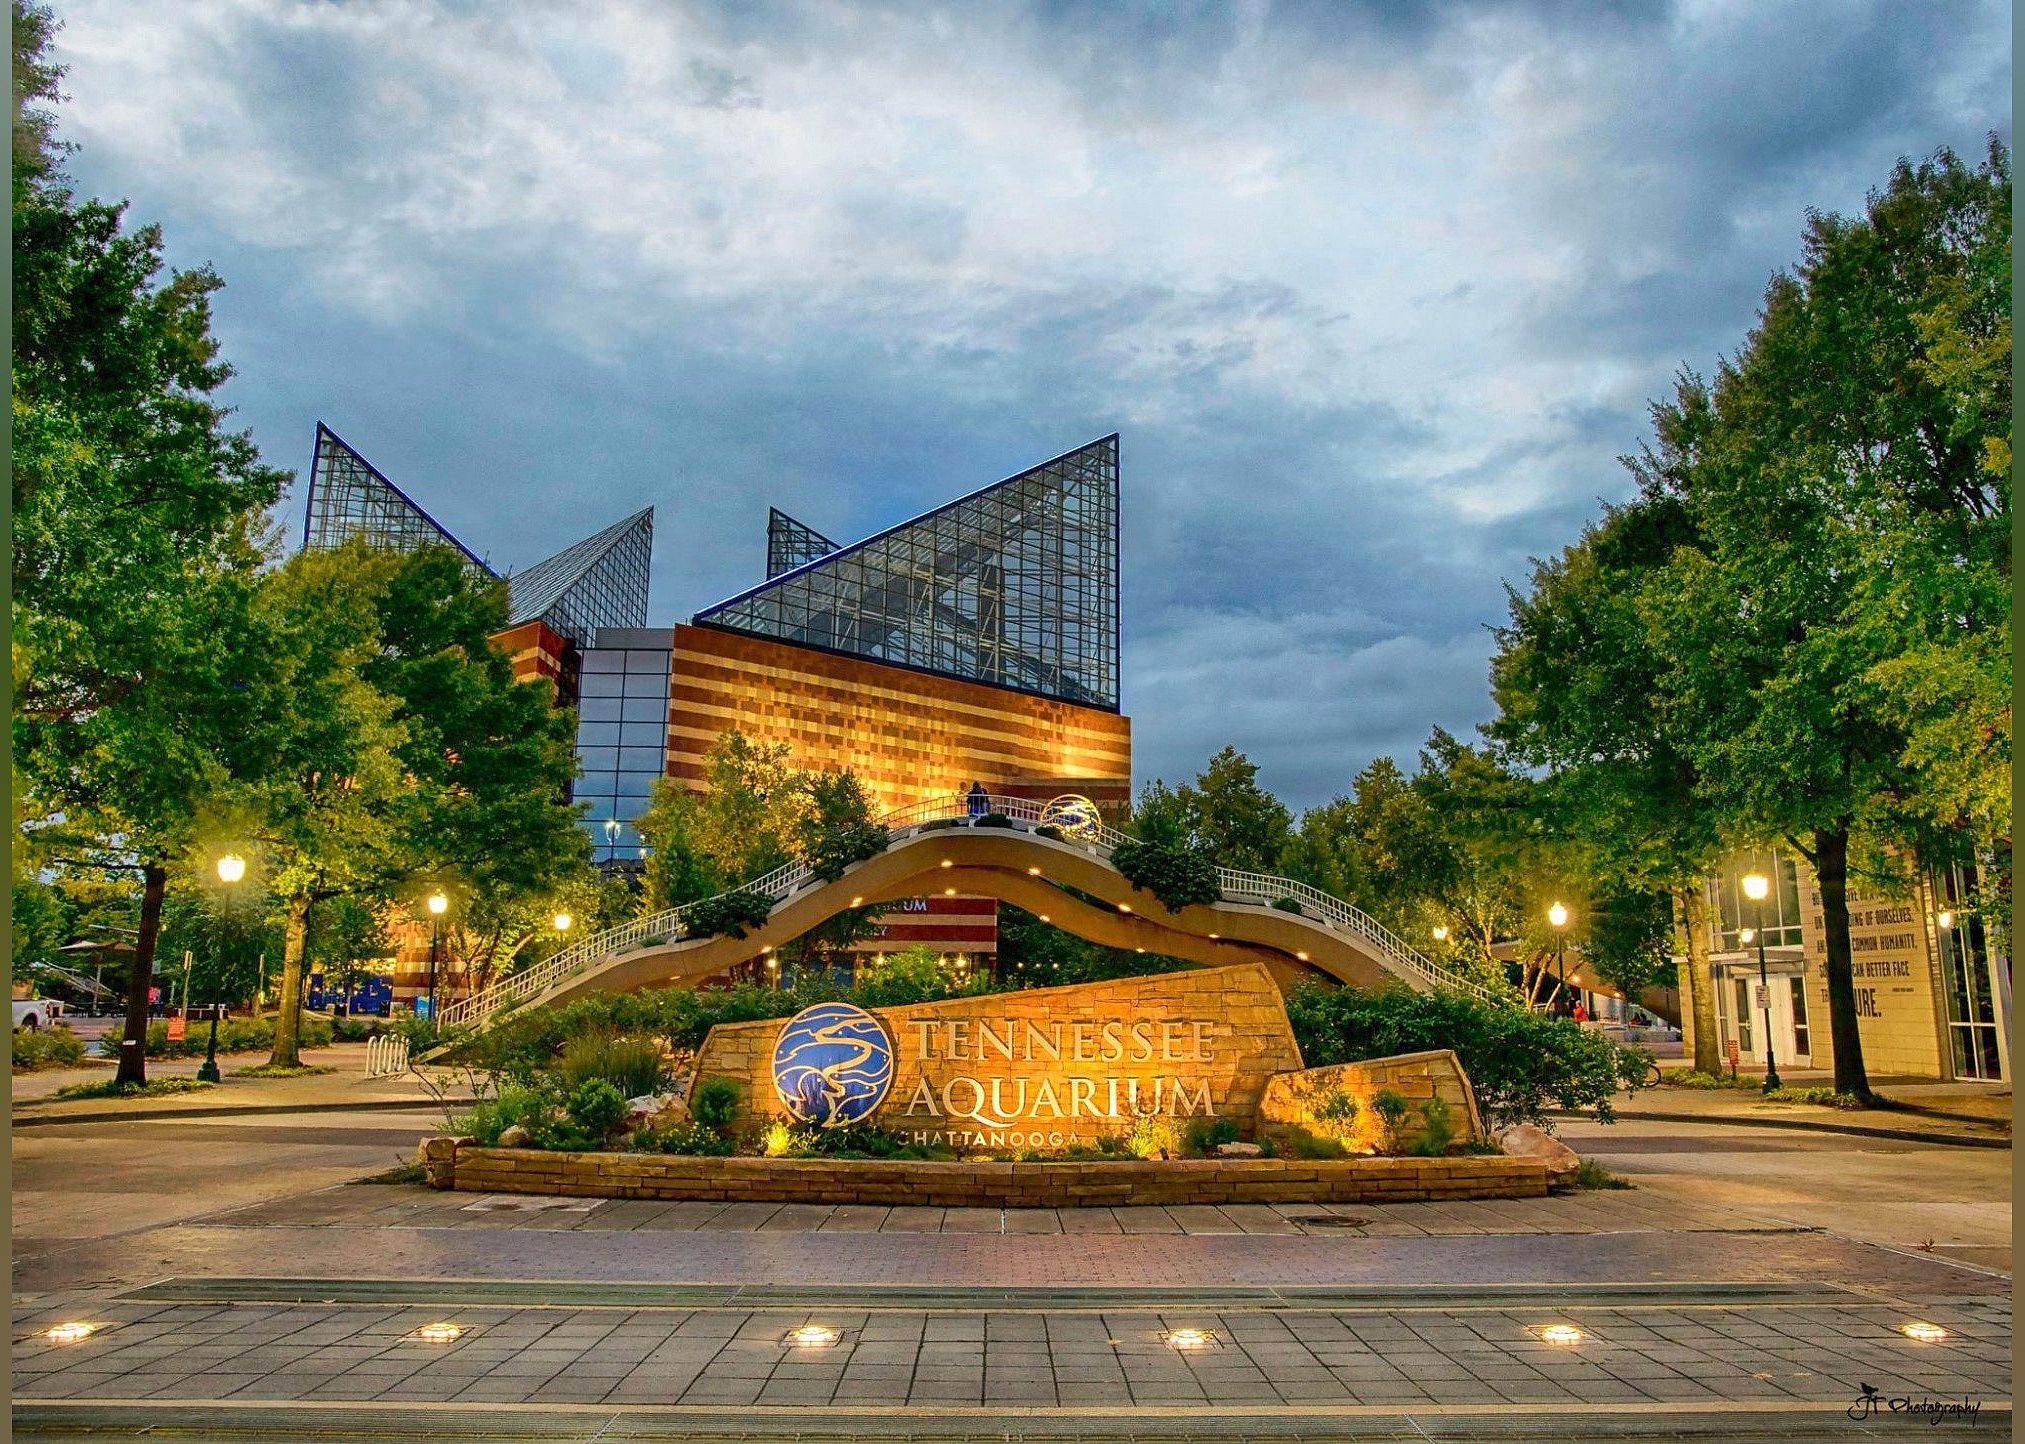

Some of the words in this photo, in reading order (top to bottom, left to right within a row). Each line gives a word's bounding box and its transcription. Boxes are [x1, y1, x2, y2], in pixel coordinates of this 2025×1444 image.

[1853, 936, 1878, 952] COMMON
[1866, 961, 1891, 977] BETTER
[1893, 960, 1910, 976] FACE
[1854, 988, 1882, 1018] URE.
[908, 1020, 1215, 1061] TENNESSEE
[906, 1077, 1219, 1127] AQUARIUM
[898, 1131, 1079, 1147] CHATTANOOGA
